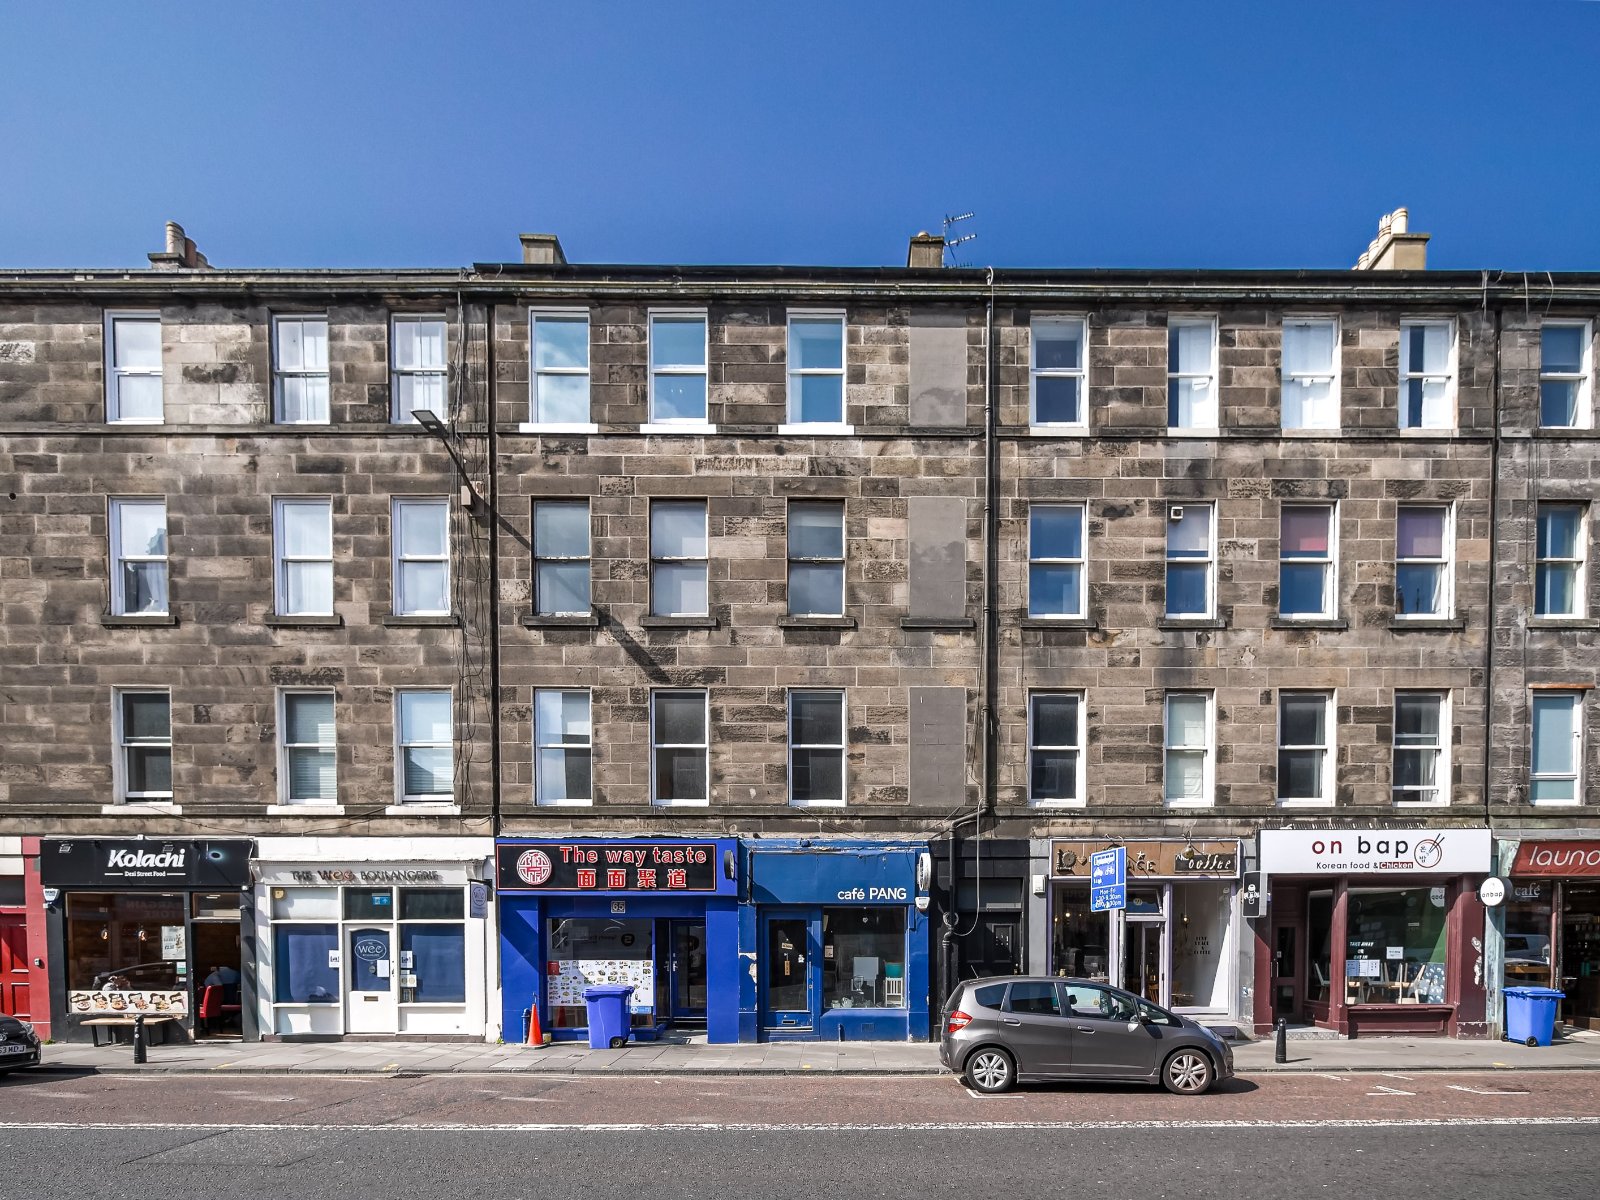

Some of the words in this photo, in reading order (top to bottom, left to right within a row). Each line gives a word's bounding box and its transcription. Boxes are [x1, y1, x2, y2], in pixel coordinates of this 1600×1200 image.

[1312, 840, 1342, 854] on
[1357, 835, 1409, 858] bap
[107, 848, 186, 868] Kolachi
[560, 846, 598, 863] The
[605, 849, 647, 867] way
[653, 846, 707, 863] taste
[1316, 861, 1348, 869] Korean
[1350, 861, 1370, 869] food
[1380, 861, 1413, 869] Chicken
[291, 870, 313, 881] THE
[360, 870, 439, 881] BOULANGERIE
[577, 868, 687, 888] 面面聚道
[837, 888, 865, 900] café
[869, 887, 907, 900] PANG
[1514, 882, 1541, 896] café
[612, 902, 625, 912] 65
